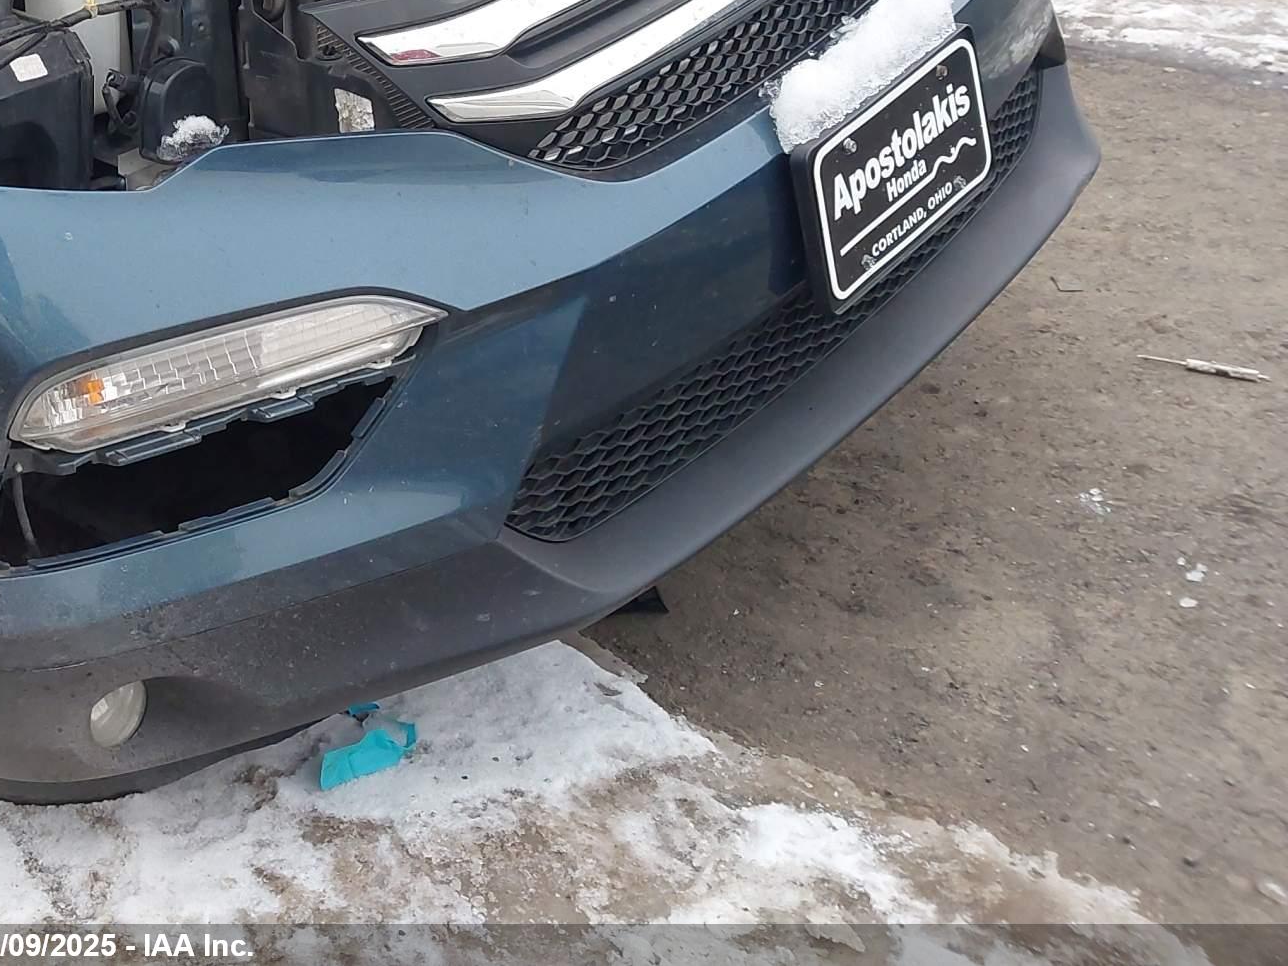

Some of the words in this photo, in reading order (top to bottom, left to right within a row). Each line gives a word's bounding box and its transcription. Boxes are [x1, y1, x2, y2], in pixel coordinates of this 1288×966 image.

[833, 84, 971, 221] Apostolakis
[886, 159, 927, 202] Honda
[871, 204, 927, 257] CORTLAND,
[928, 182, 953, 211] OHIO
